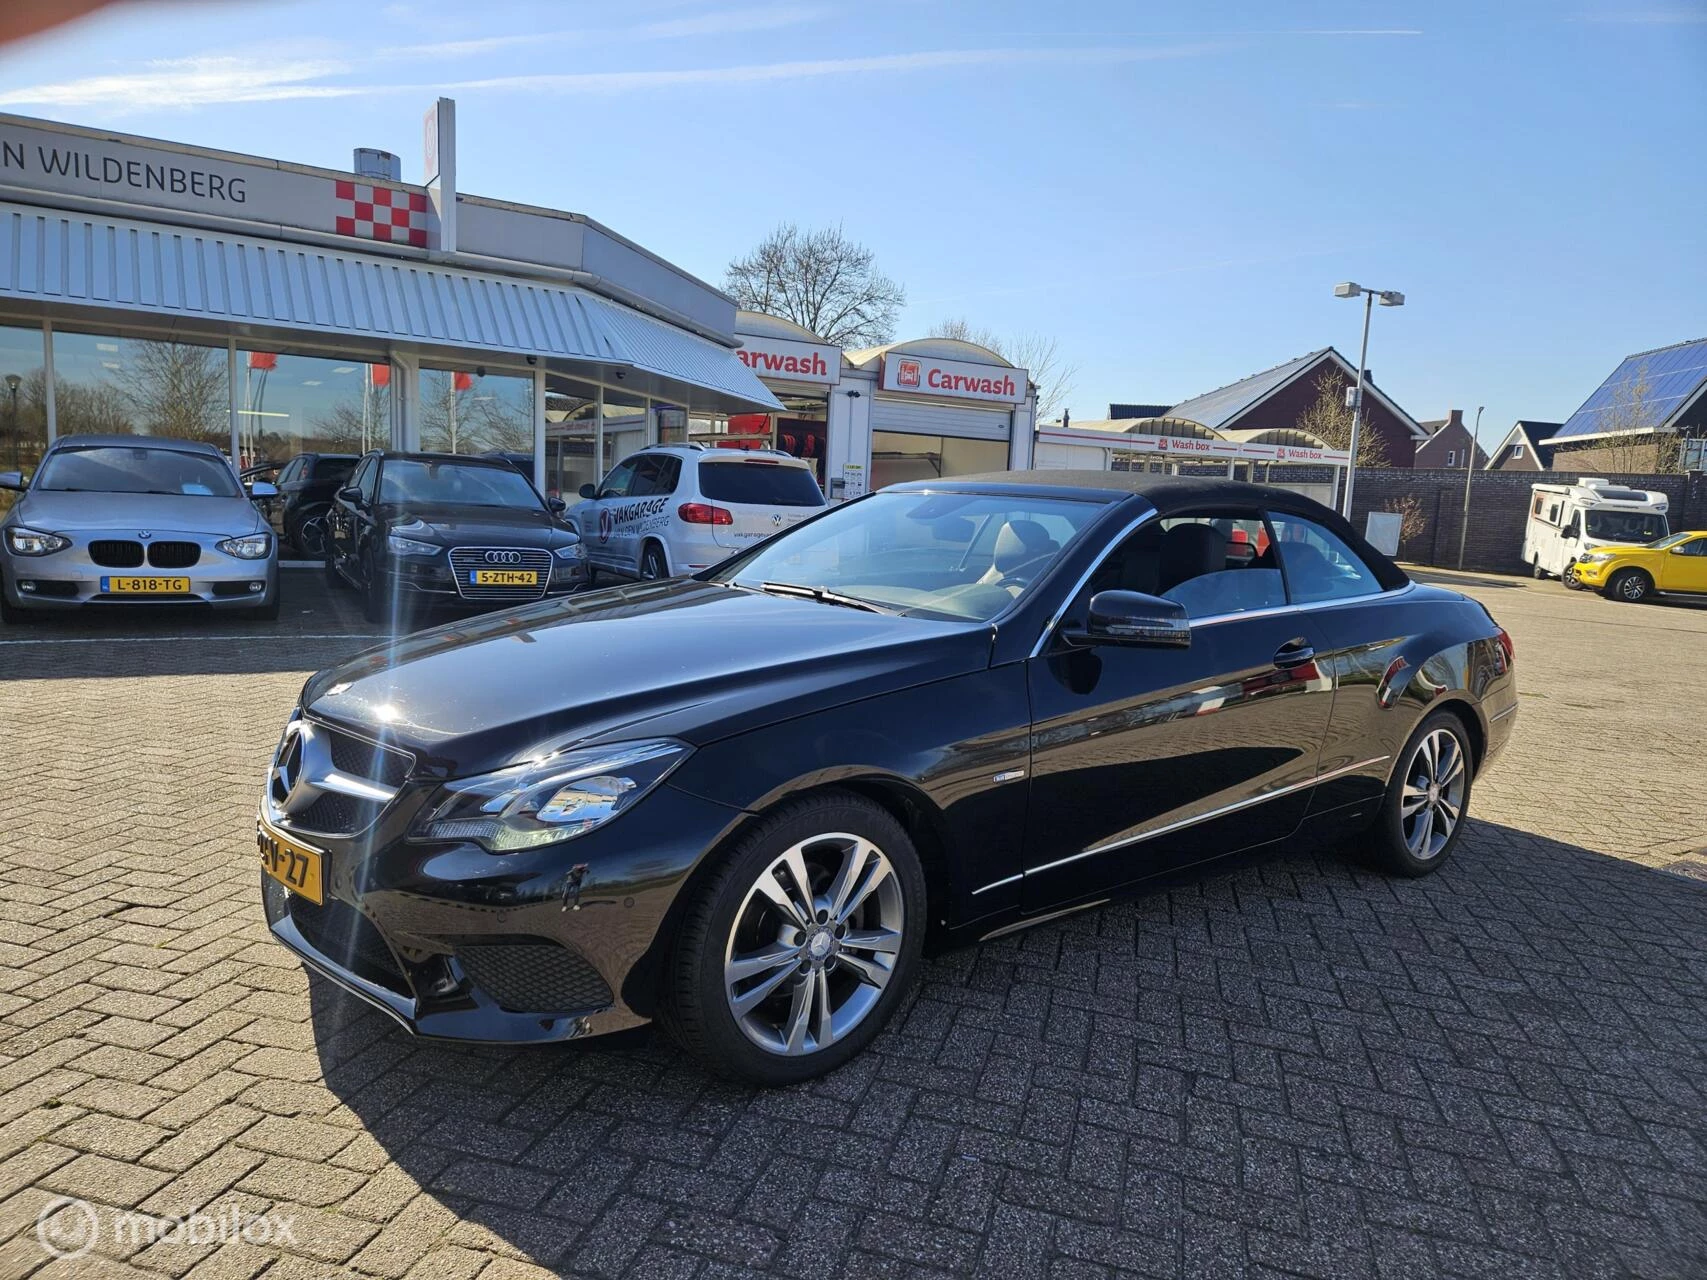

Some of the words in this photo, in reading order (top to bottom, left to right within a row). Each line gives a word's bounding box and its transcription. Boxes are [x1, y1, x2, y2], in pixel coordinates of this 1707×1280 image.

[3, 140, 25, 170] N
[38, 146, 247, 203] WILDENBERG
[736, 350, 828, 376] arwash
[927, 368, 1016, 397] Carwash
[1171, 440, 1194, 450] Wash
[1195, 440, 1211, 451] box
[1288, 449, 1310, 459] Wash
[1311, 450, 1322, 460] box
[613, 497, 670, 525] VAKGARAGE
[117, 579, 182, 590] L-818-TG
[481, 572, 533, 583] 5-ZTH-42
